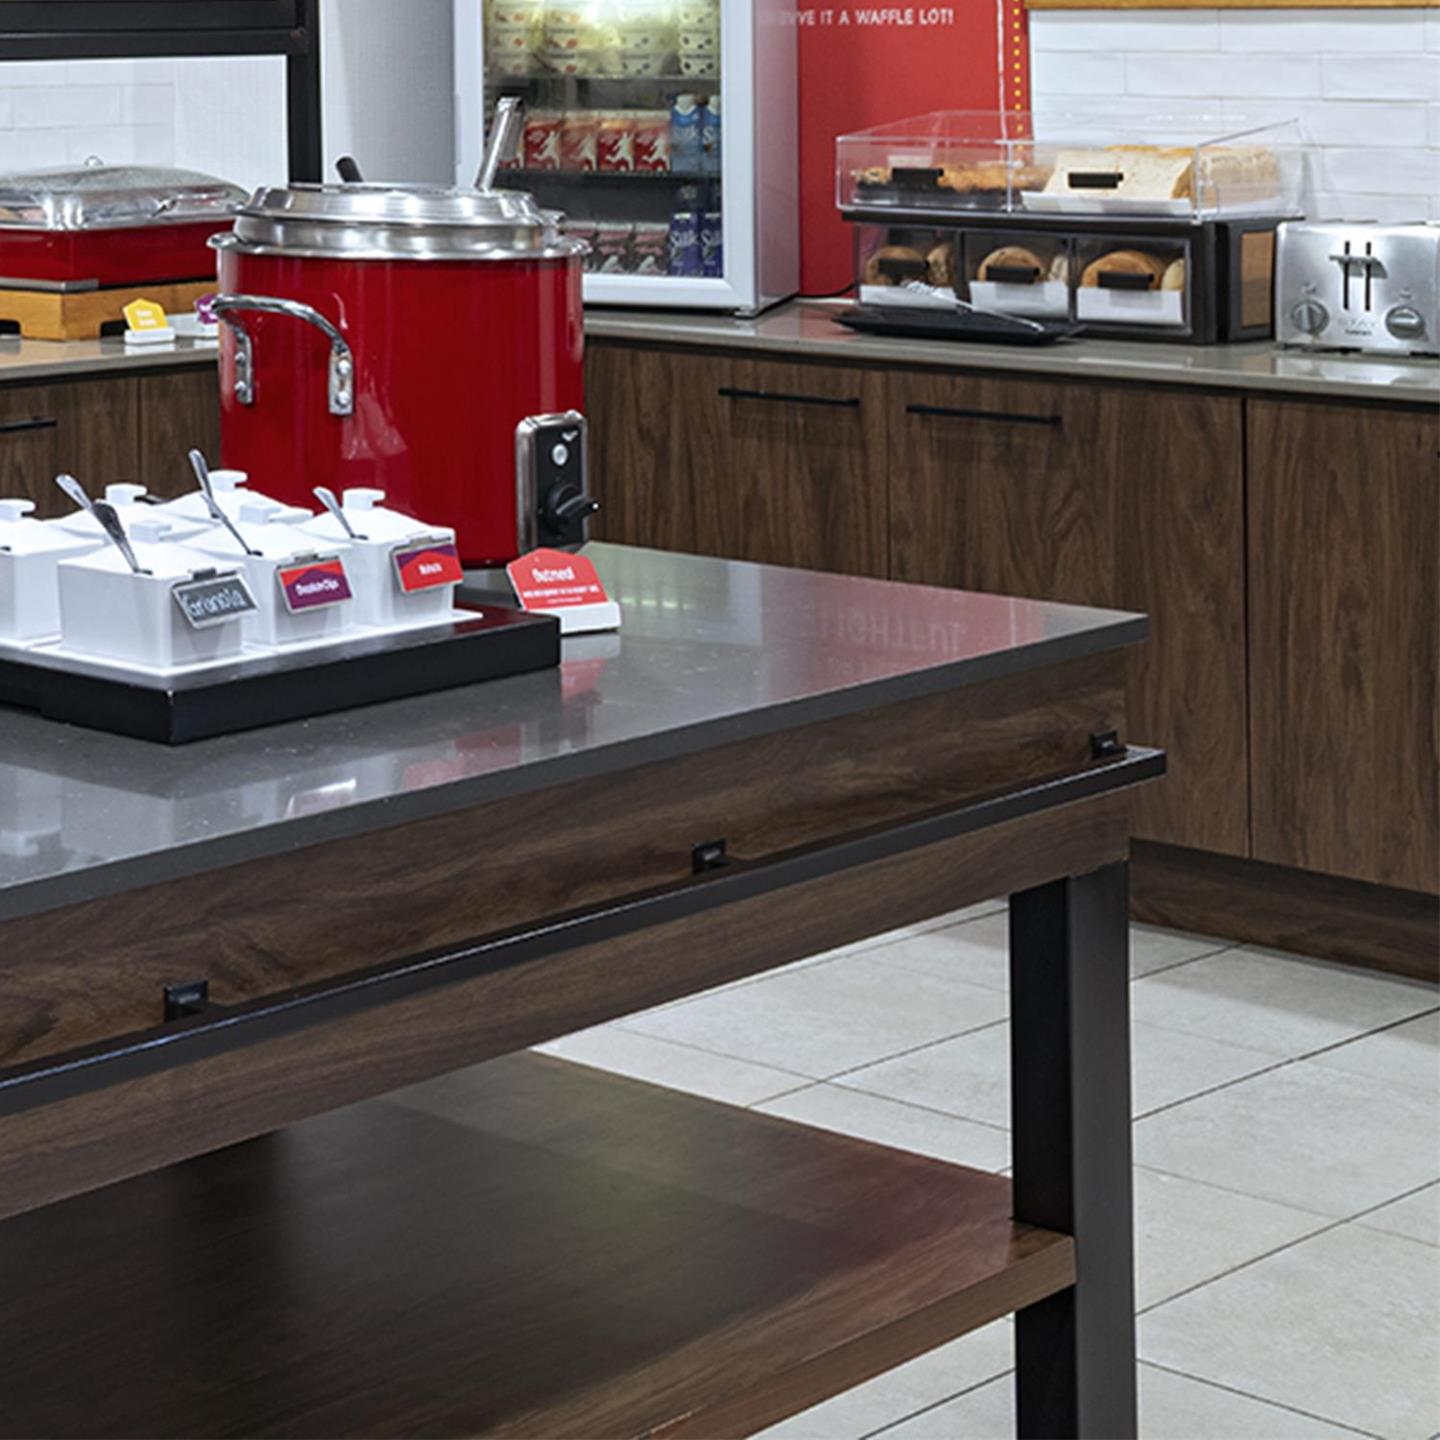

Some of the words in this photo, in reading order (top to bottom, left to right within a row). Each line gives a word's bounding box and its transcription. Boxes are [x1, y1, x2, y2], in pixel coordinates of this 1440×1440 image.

[820, 9, 834, 26] IT
[839, 9, 851, 26] A
[855, 9, 913, 26] WAFFLE
[919, 8, 954, 25] LOT!
[181, 587, 249, 618] Granola
